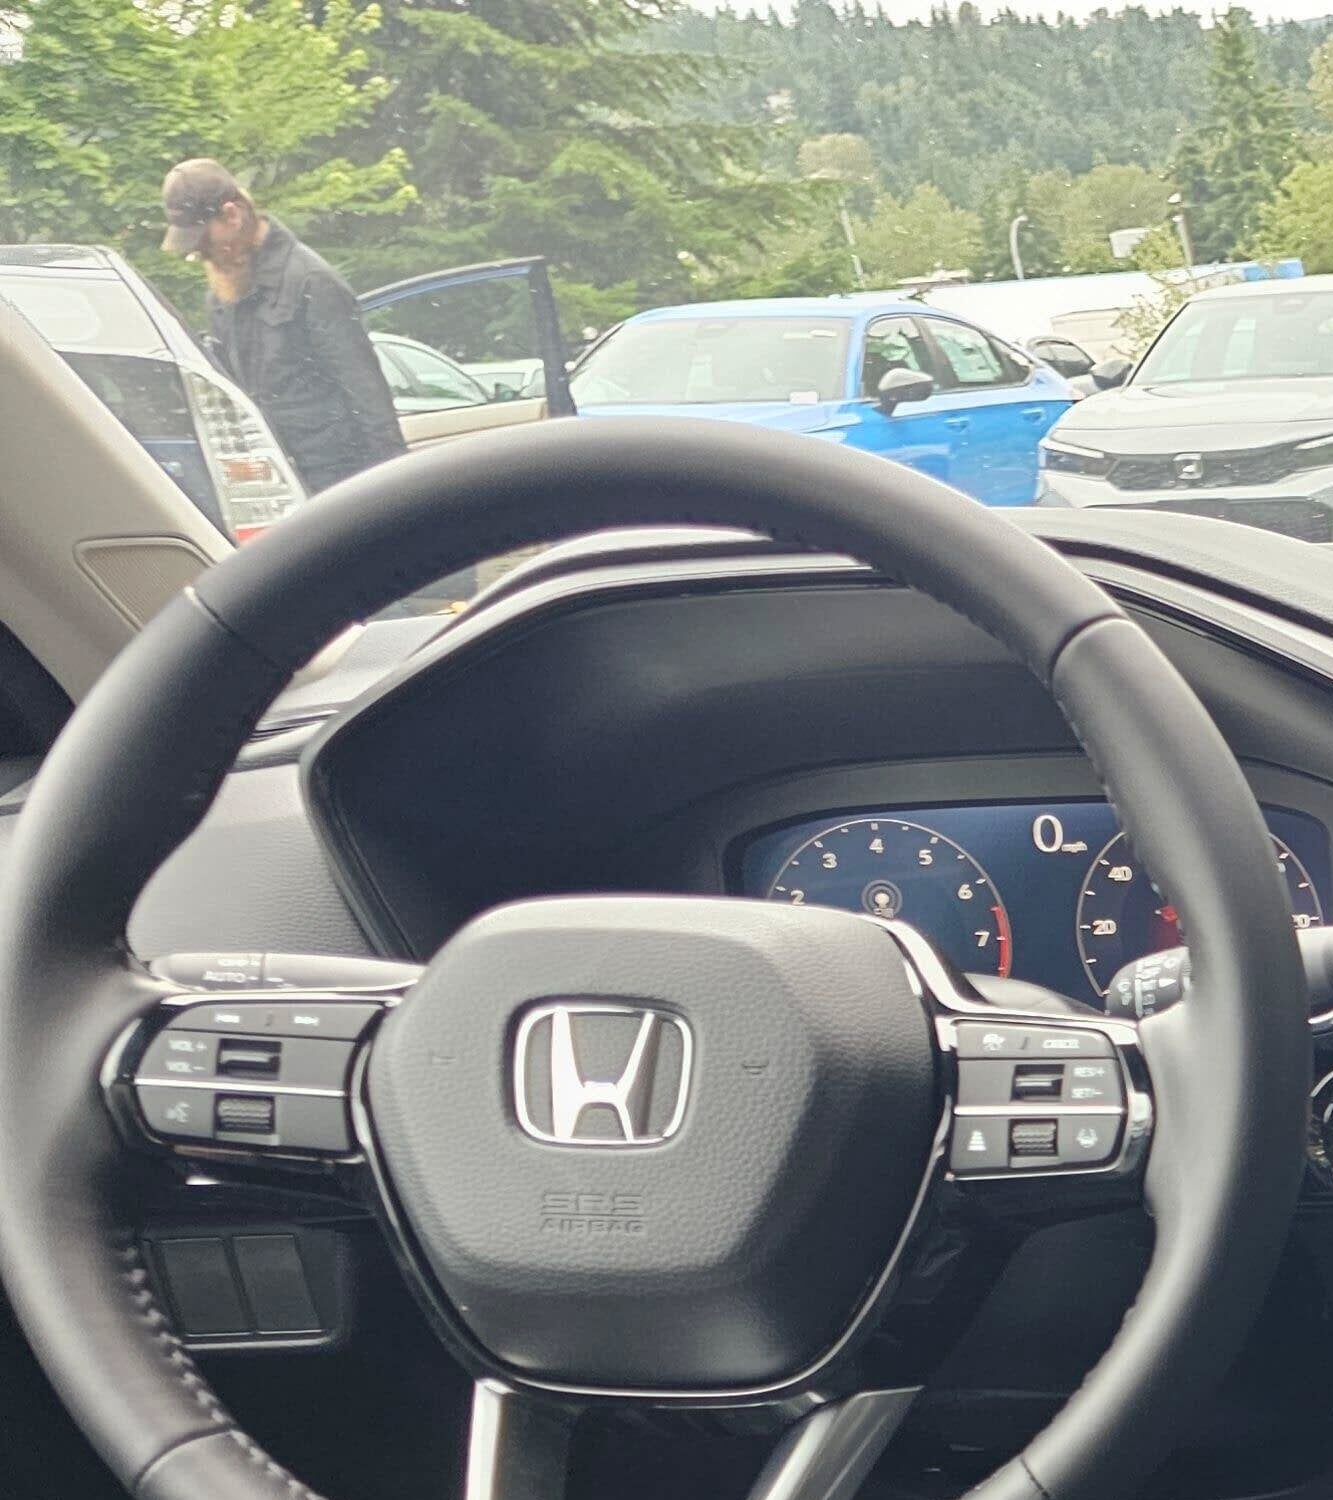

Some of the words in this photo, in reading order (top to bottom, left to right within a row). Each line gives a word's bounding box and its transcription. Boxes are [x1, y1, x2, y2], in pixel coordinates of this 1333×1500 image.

[1033, 814, 1064, 853] 0
[869, 838, 885, 853] 4
[822, 852, 838, 869] 3
[918, 849, 933, 866] 5
[1107, 866, 1133, 882] 40
[790, 889, 805, 906] 2
[957, 884, 973, 900] 6
[1092, 919, 1117, 936] 20
[974, 931, 990, 947] 7
